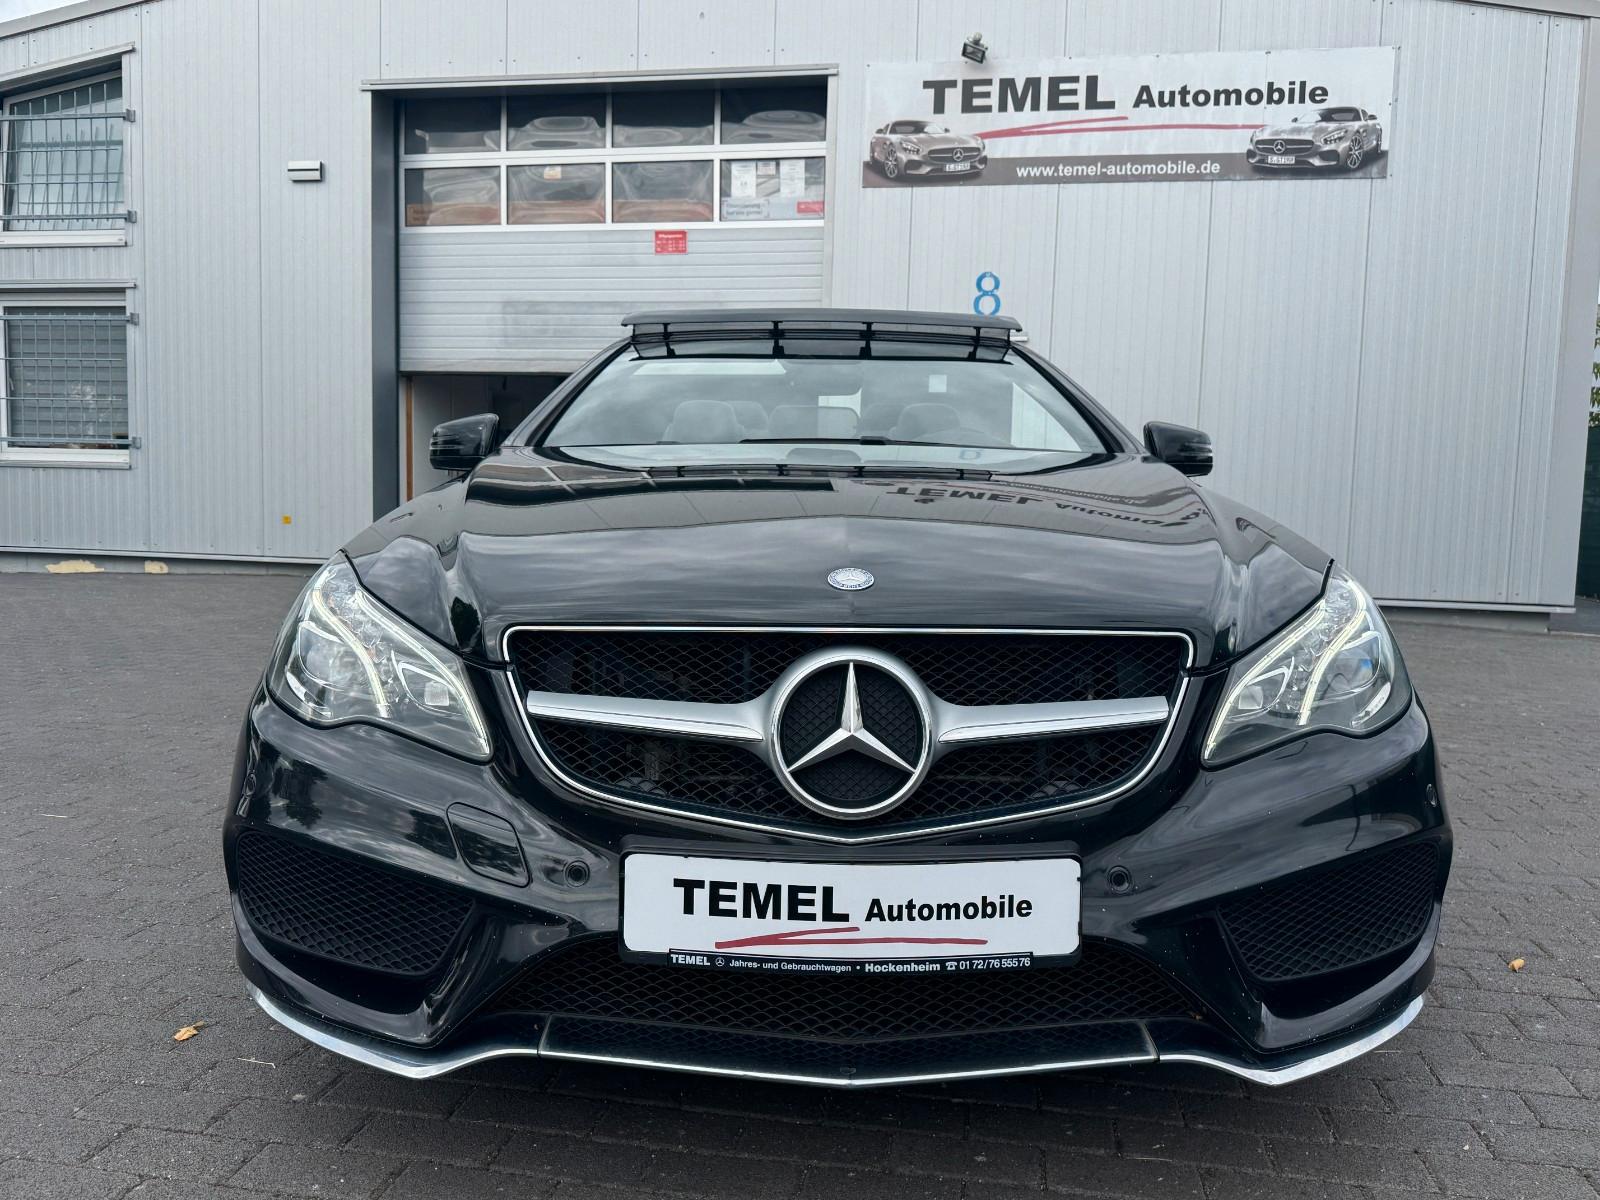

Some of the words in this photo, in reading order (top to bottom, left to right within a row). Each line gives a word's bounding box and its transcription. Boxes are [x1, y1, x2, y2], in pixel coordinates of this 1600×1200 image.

[922, 75, 1116, 114] TEMEL
[1132, 80, 1329, 109] Automobile
[1016, 160, 1221, 177] www.temel-automobile.de
[973, 271, 1001, 316] 8
[673, 878, 849, 922] TEMEL
[864, 894, 1033, 922] Automobile
[670, 953, 711, 966] TEMEL
[729, 959, 761, 969] Jahres-
[762, 961, 779, 970] und
[780, 962, 852, 973] Gebrauchtwagen
[865, 962, 941, 972] Hockenheim
